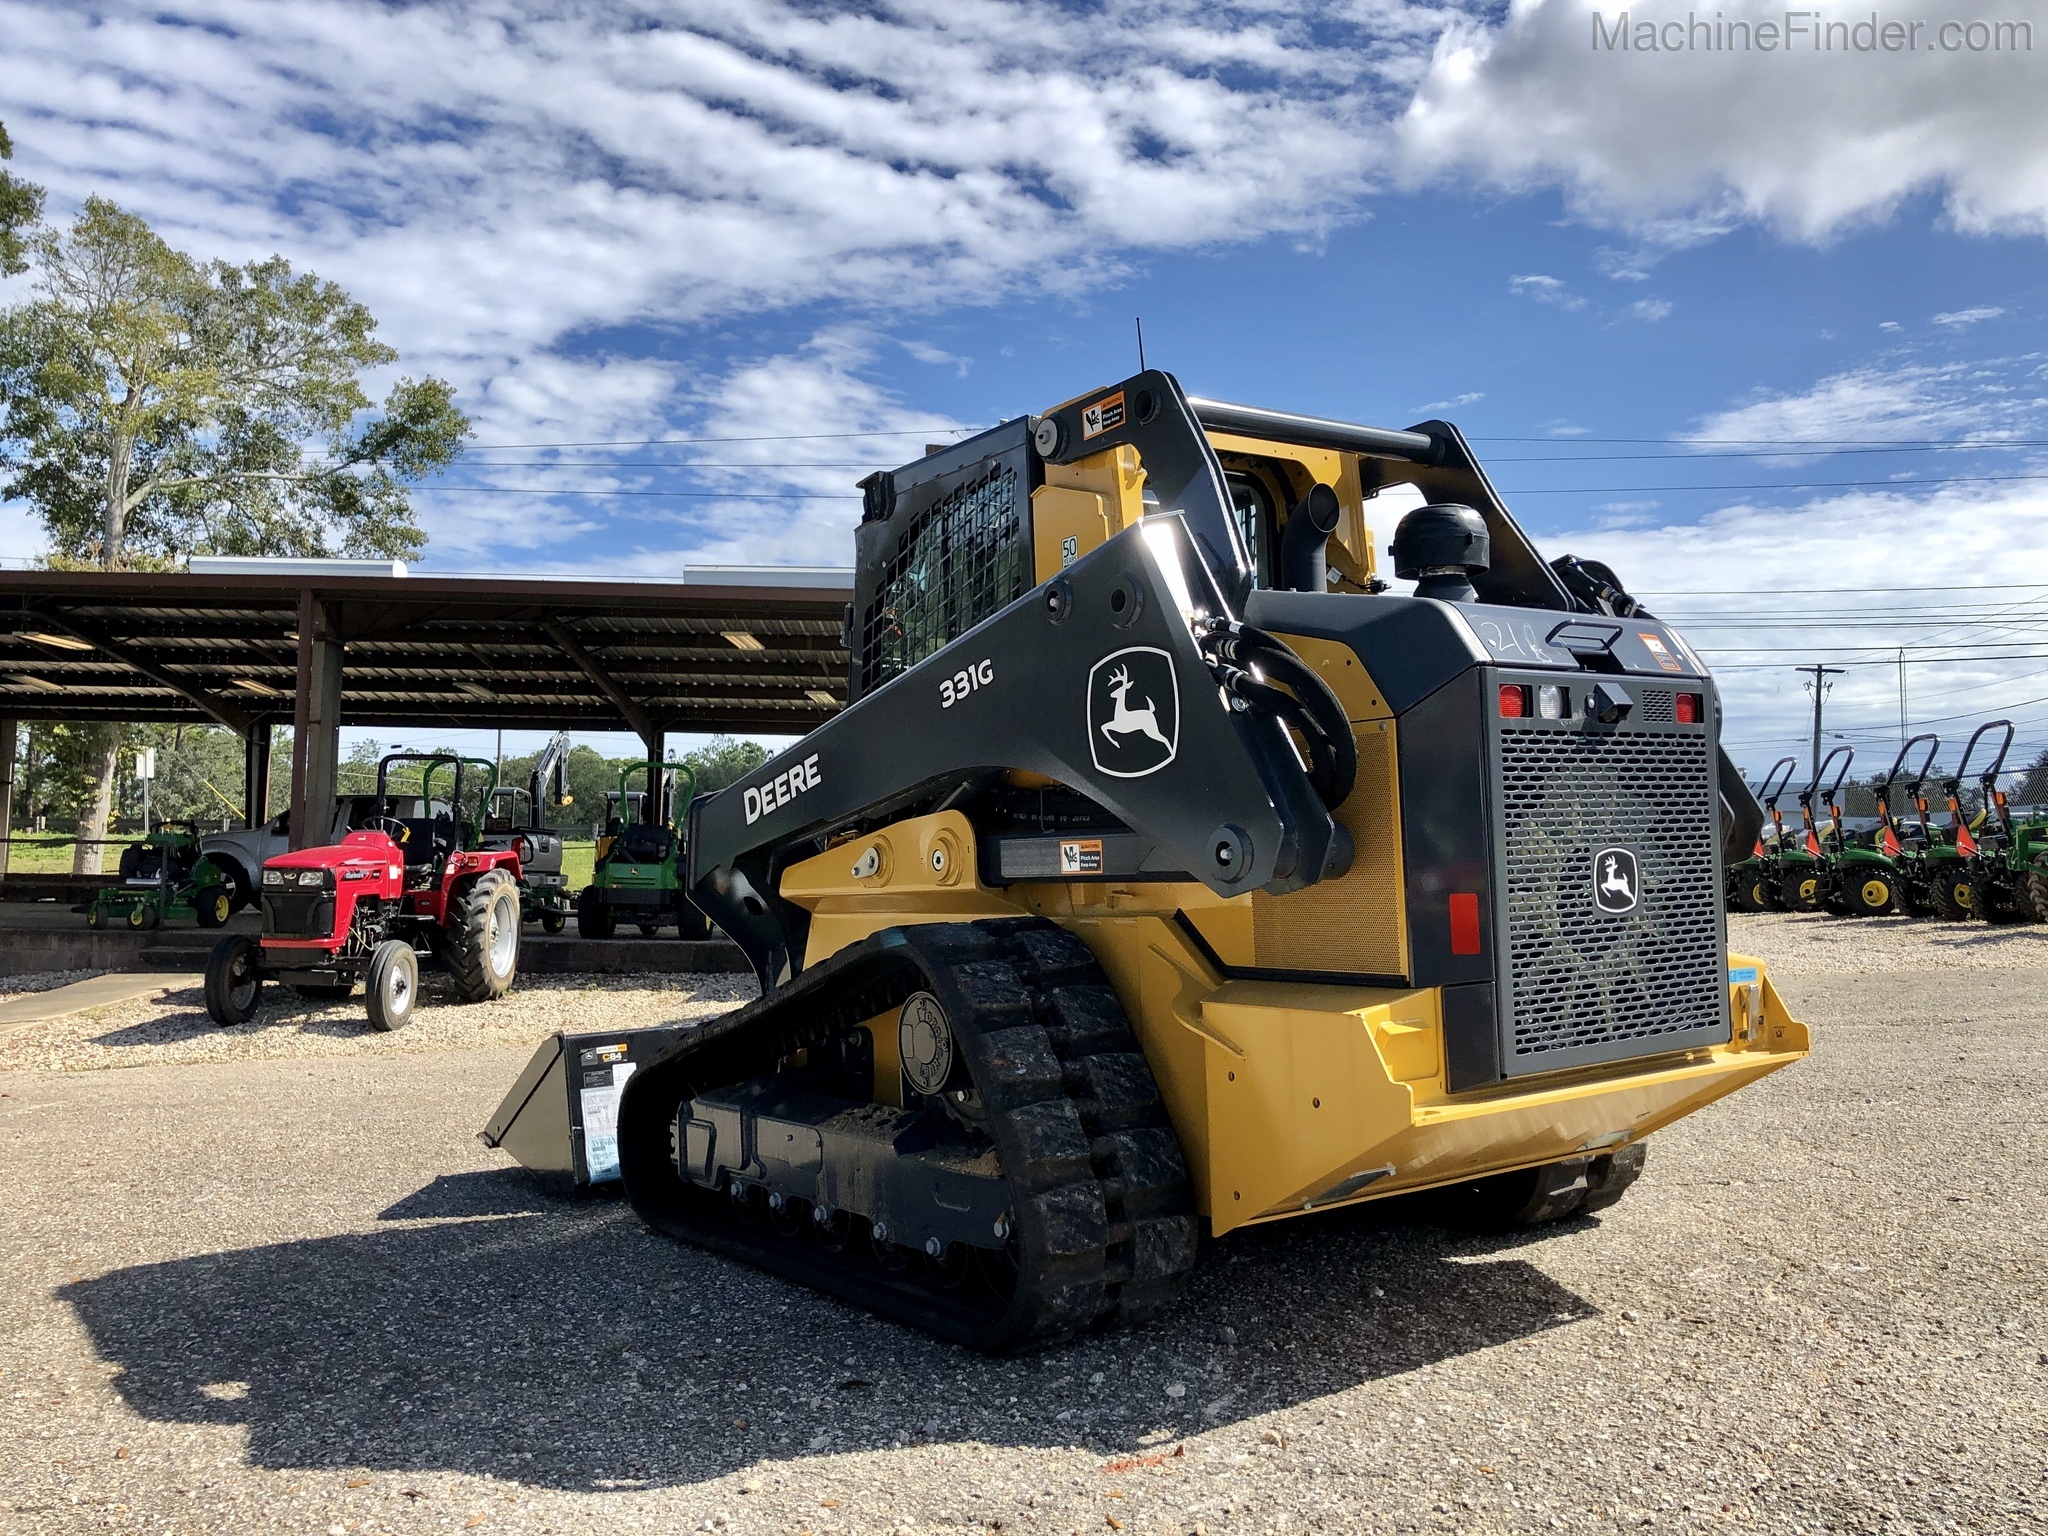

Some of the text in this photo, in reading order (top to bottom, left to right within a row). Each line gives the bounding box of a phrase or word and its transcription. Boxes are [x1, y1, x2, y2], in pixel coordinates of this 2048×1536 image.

[1063, 538, 1076, 558] 50
[939, 658, 994, 709] 331G
[743, 753, 822, 826] DEERE
[602, 1052, 622, 1061] C84
